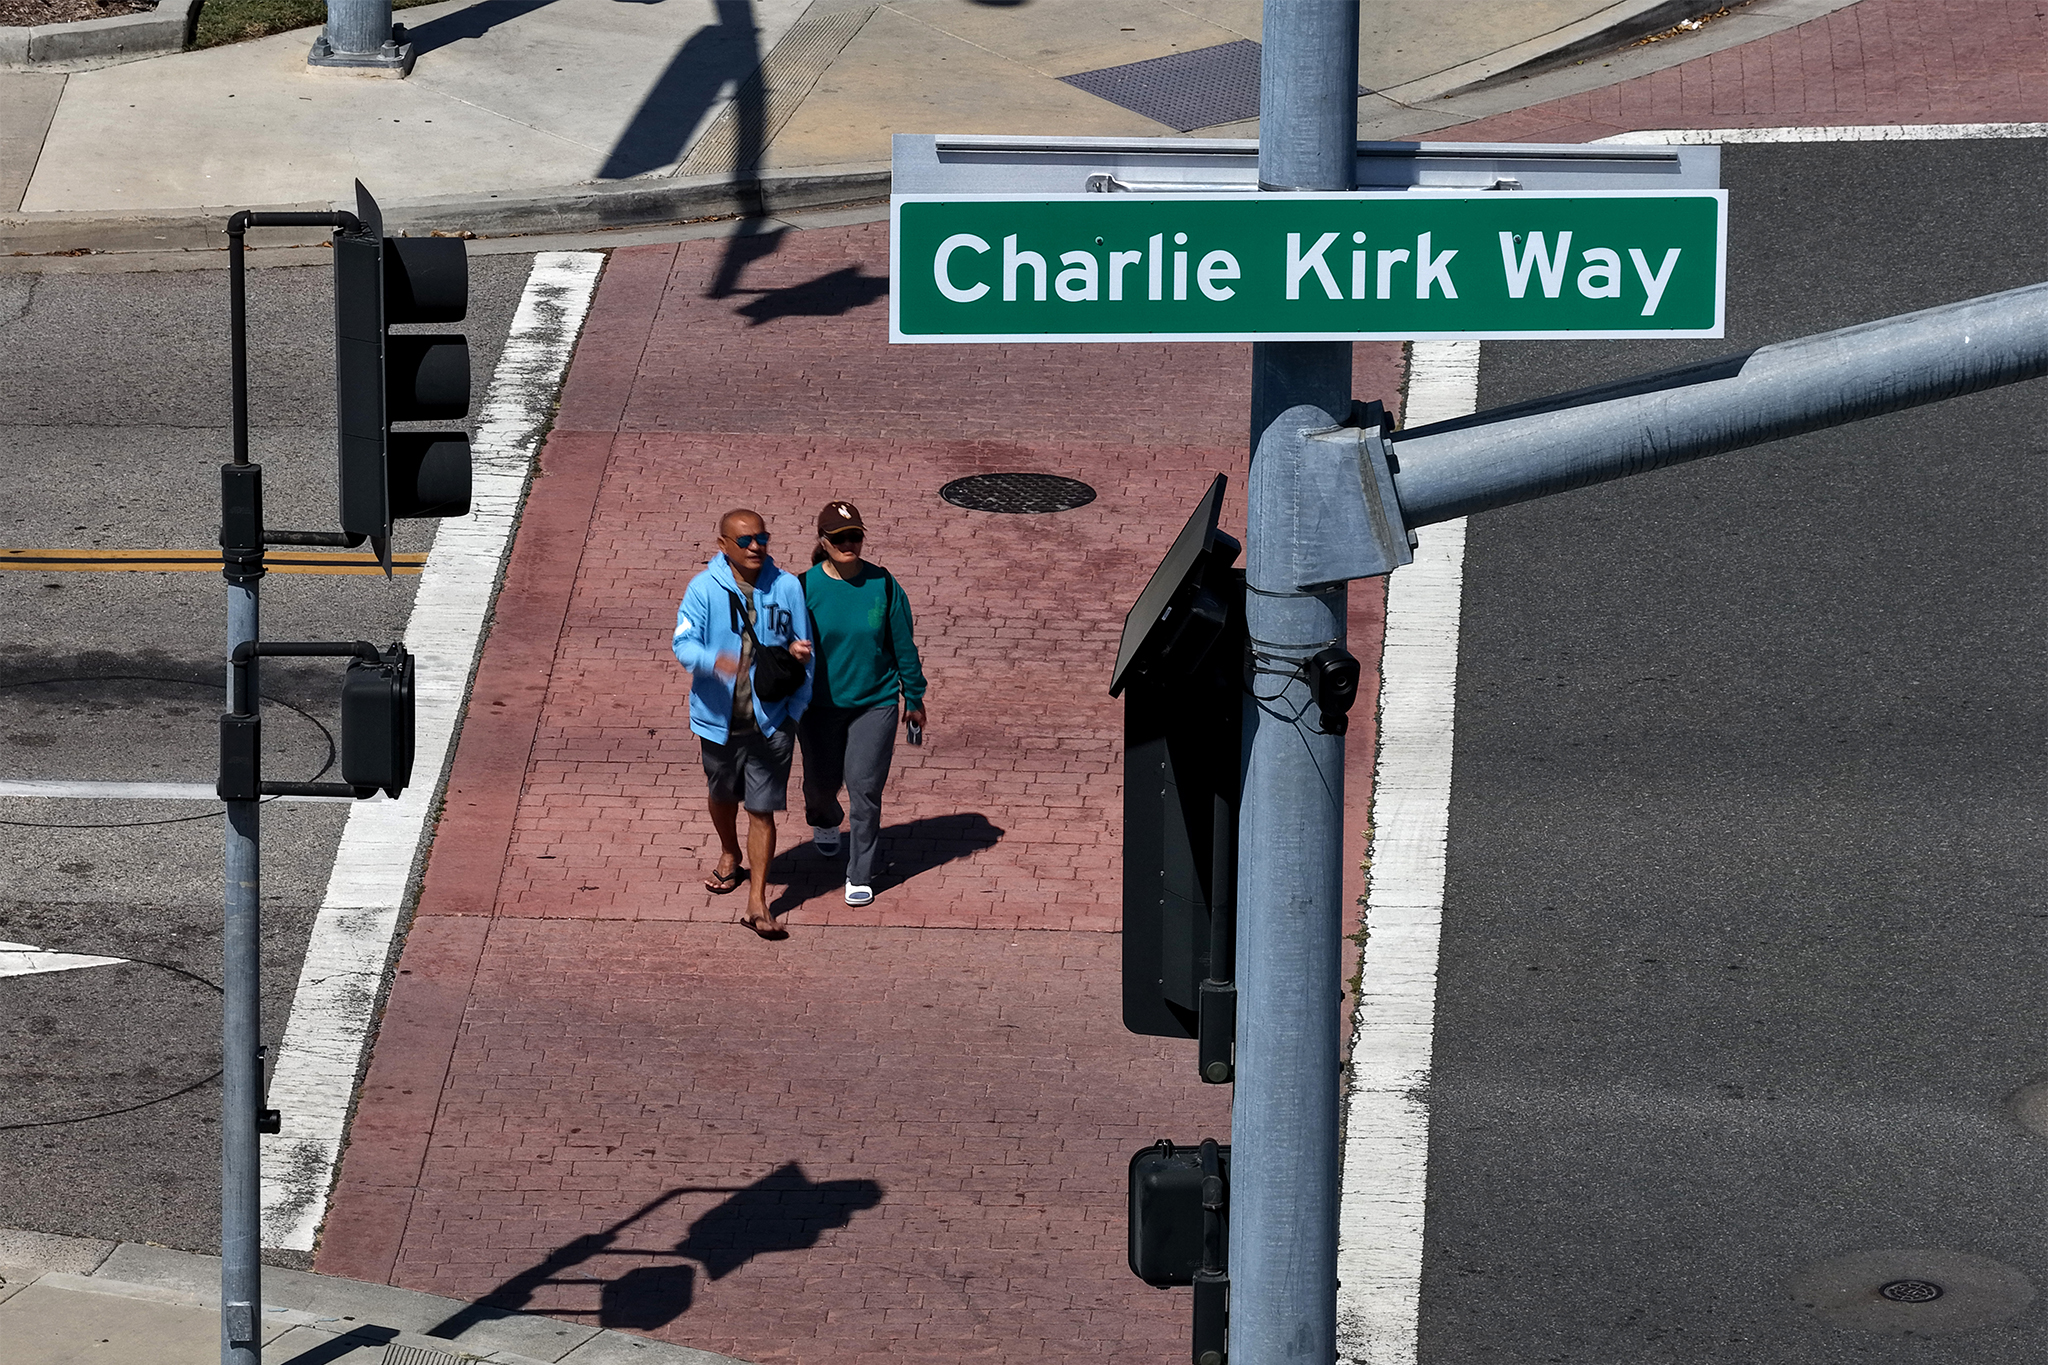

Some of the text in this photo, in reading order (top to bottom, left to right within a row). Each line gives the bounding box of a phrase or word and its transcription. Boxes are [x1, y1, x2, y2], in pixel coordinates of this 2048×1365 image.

[933, 231, 1682, 316] Charlie Kirk Way
